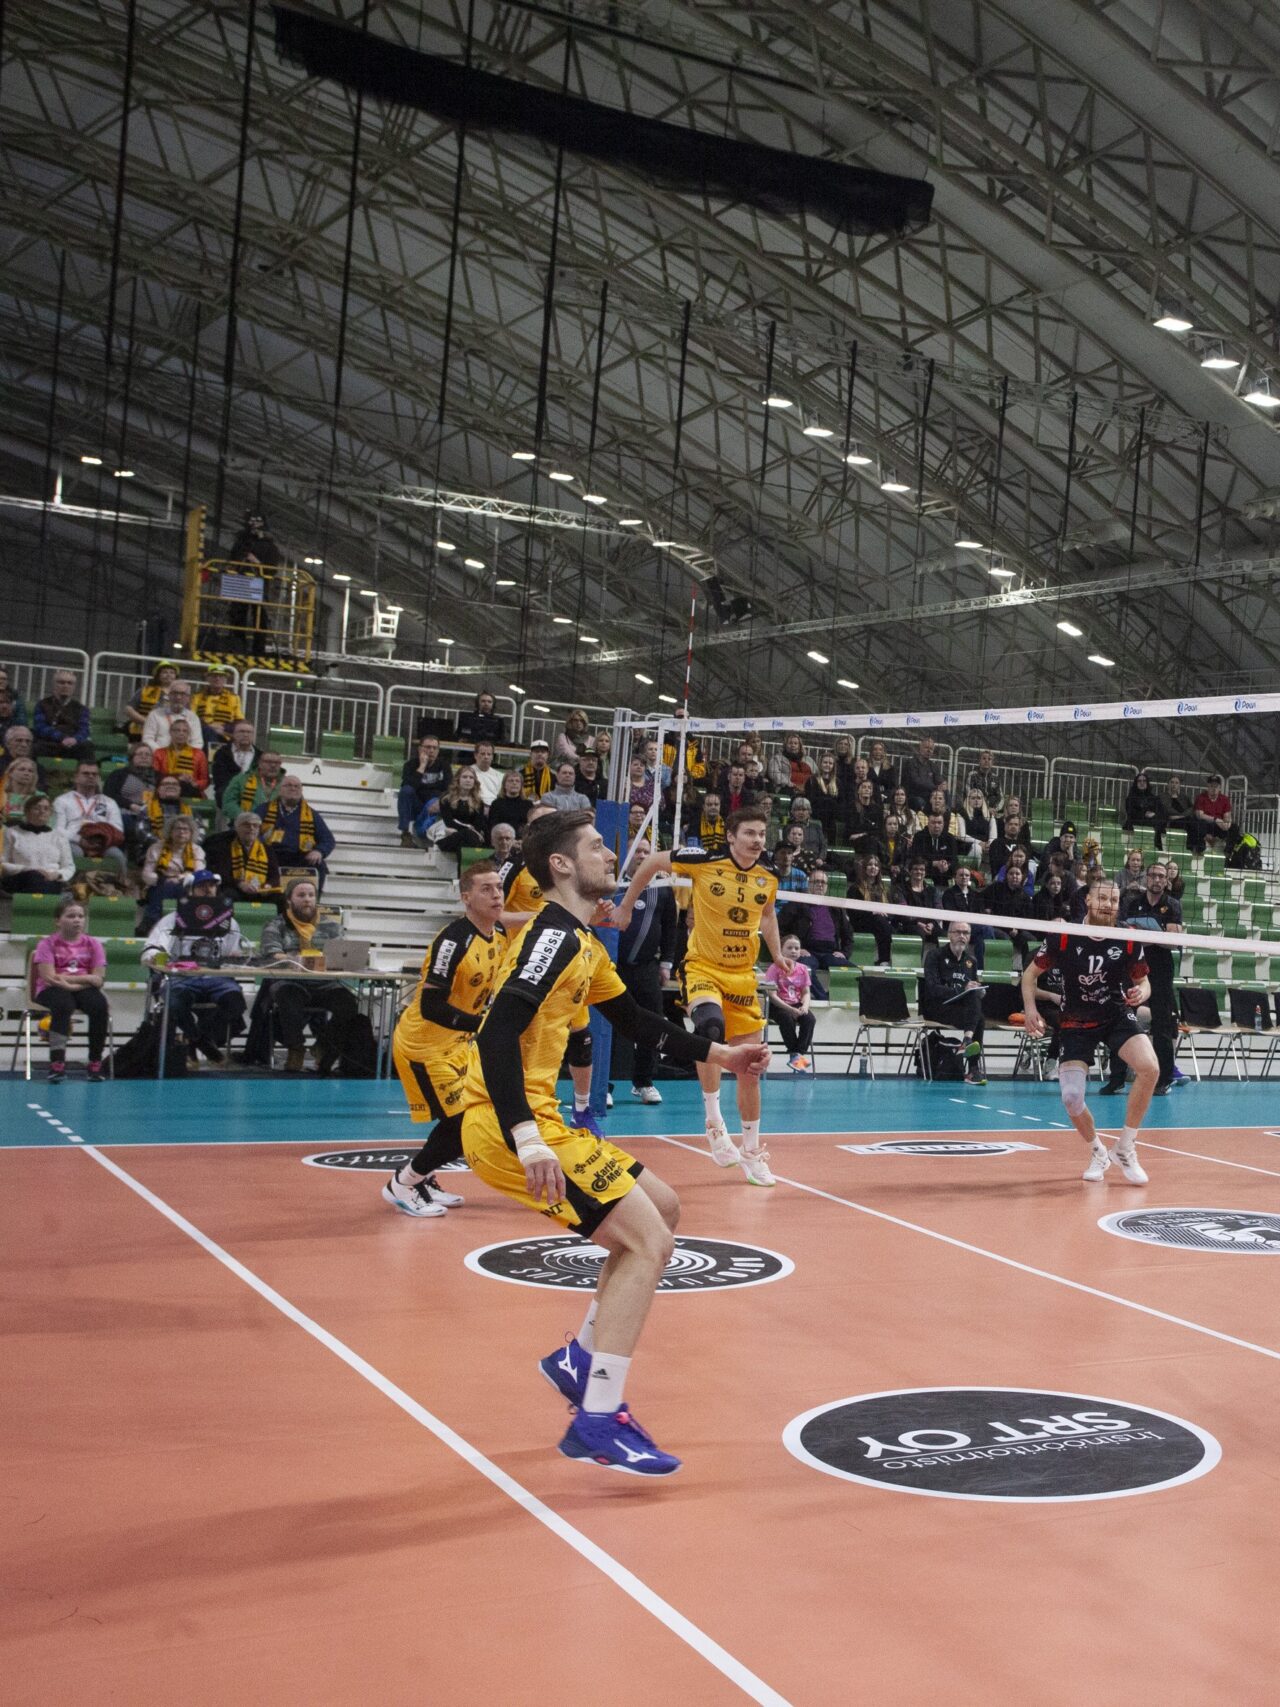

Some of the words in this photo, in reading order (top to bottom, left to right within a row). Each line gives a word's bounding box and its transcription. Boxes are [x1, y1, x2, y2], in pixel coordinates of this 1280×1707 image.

[527, 930, 563, 982] PONSSE
[1088, 954, 1104, 974] 12
[988, 1412, 1132, 1442] SRT
[857, 1429, 972, 1459] OY
[883, 1430, 1166, 1470] Insinööritoimisto
